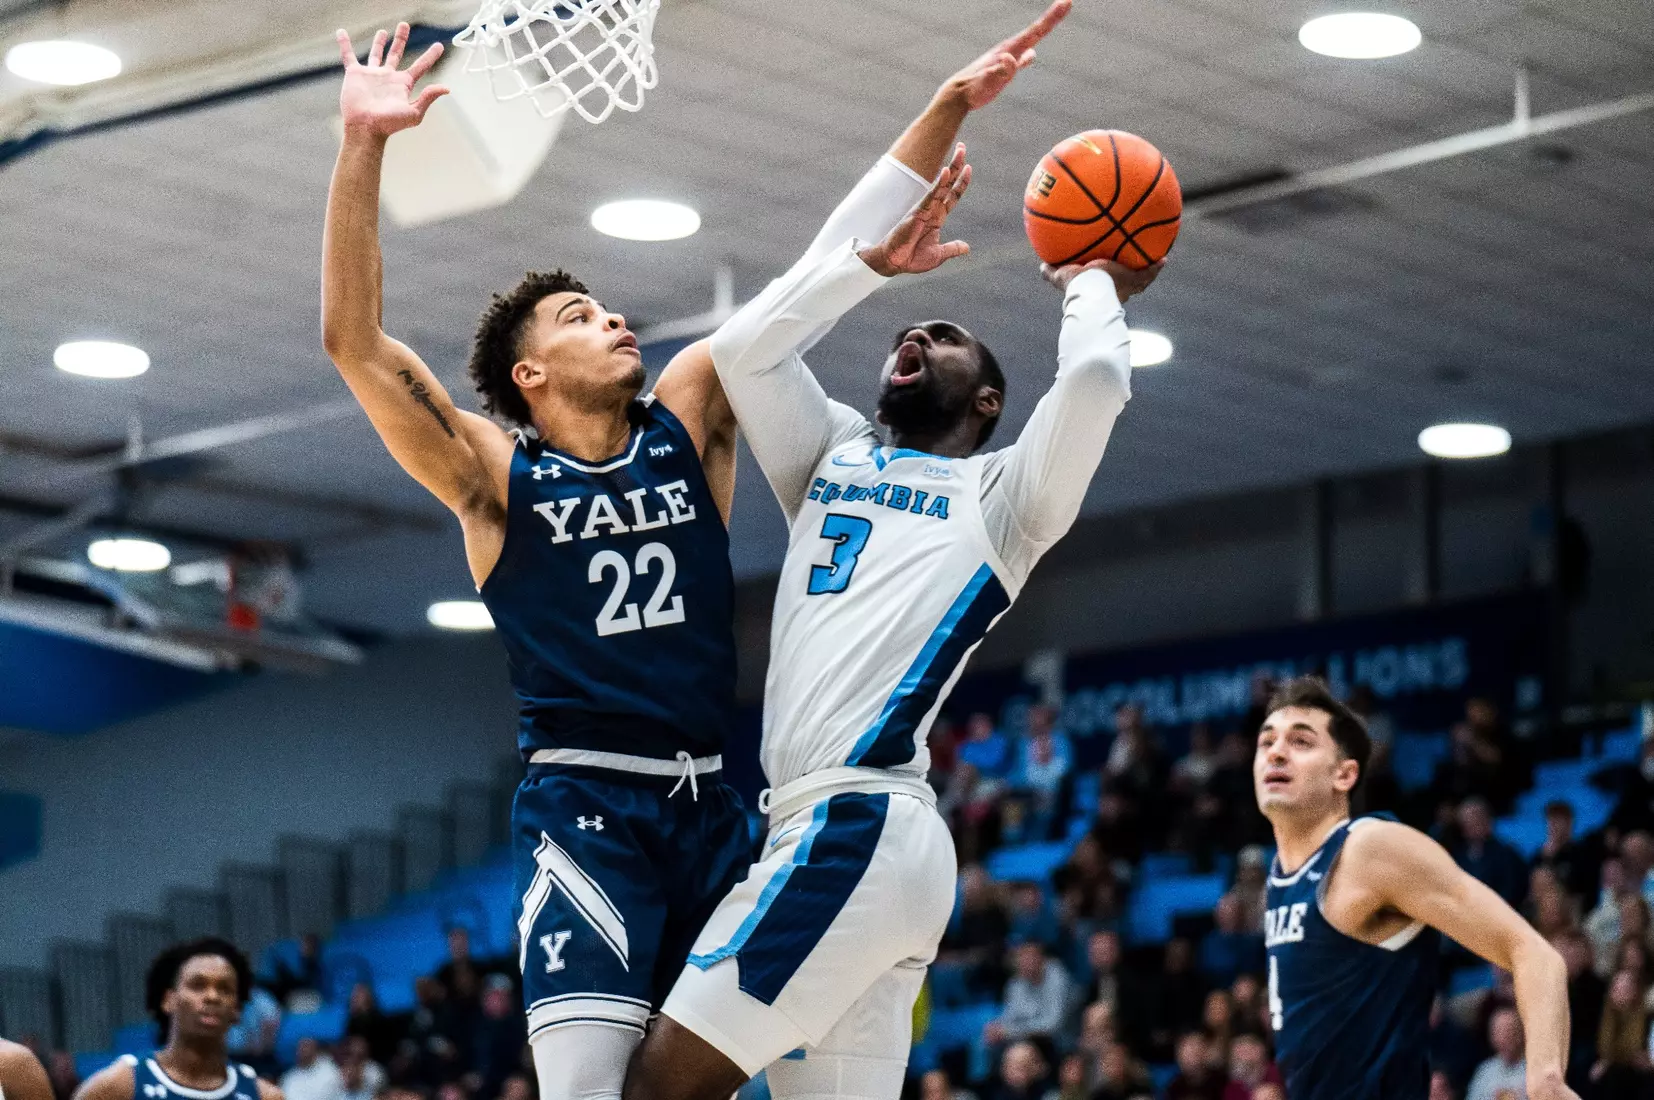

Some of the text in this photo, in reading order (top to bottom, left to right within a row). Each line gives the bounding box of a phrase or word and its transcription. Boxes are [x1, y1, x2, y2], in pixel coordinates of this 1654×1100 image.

[532, 479, 697, 544] YALE
[807, 477, 950, 520] COUMBIA
[807, 512, 873, 595] 3
[588, 542, 686, 637] 22
[539, 930, 572, 973] Y
[1264, 902, 1308, 949] ALE
